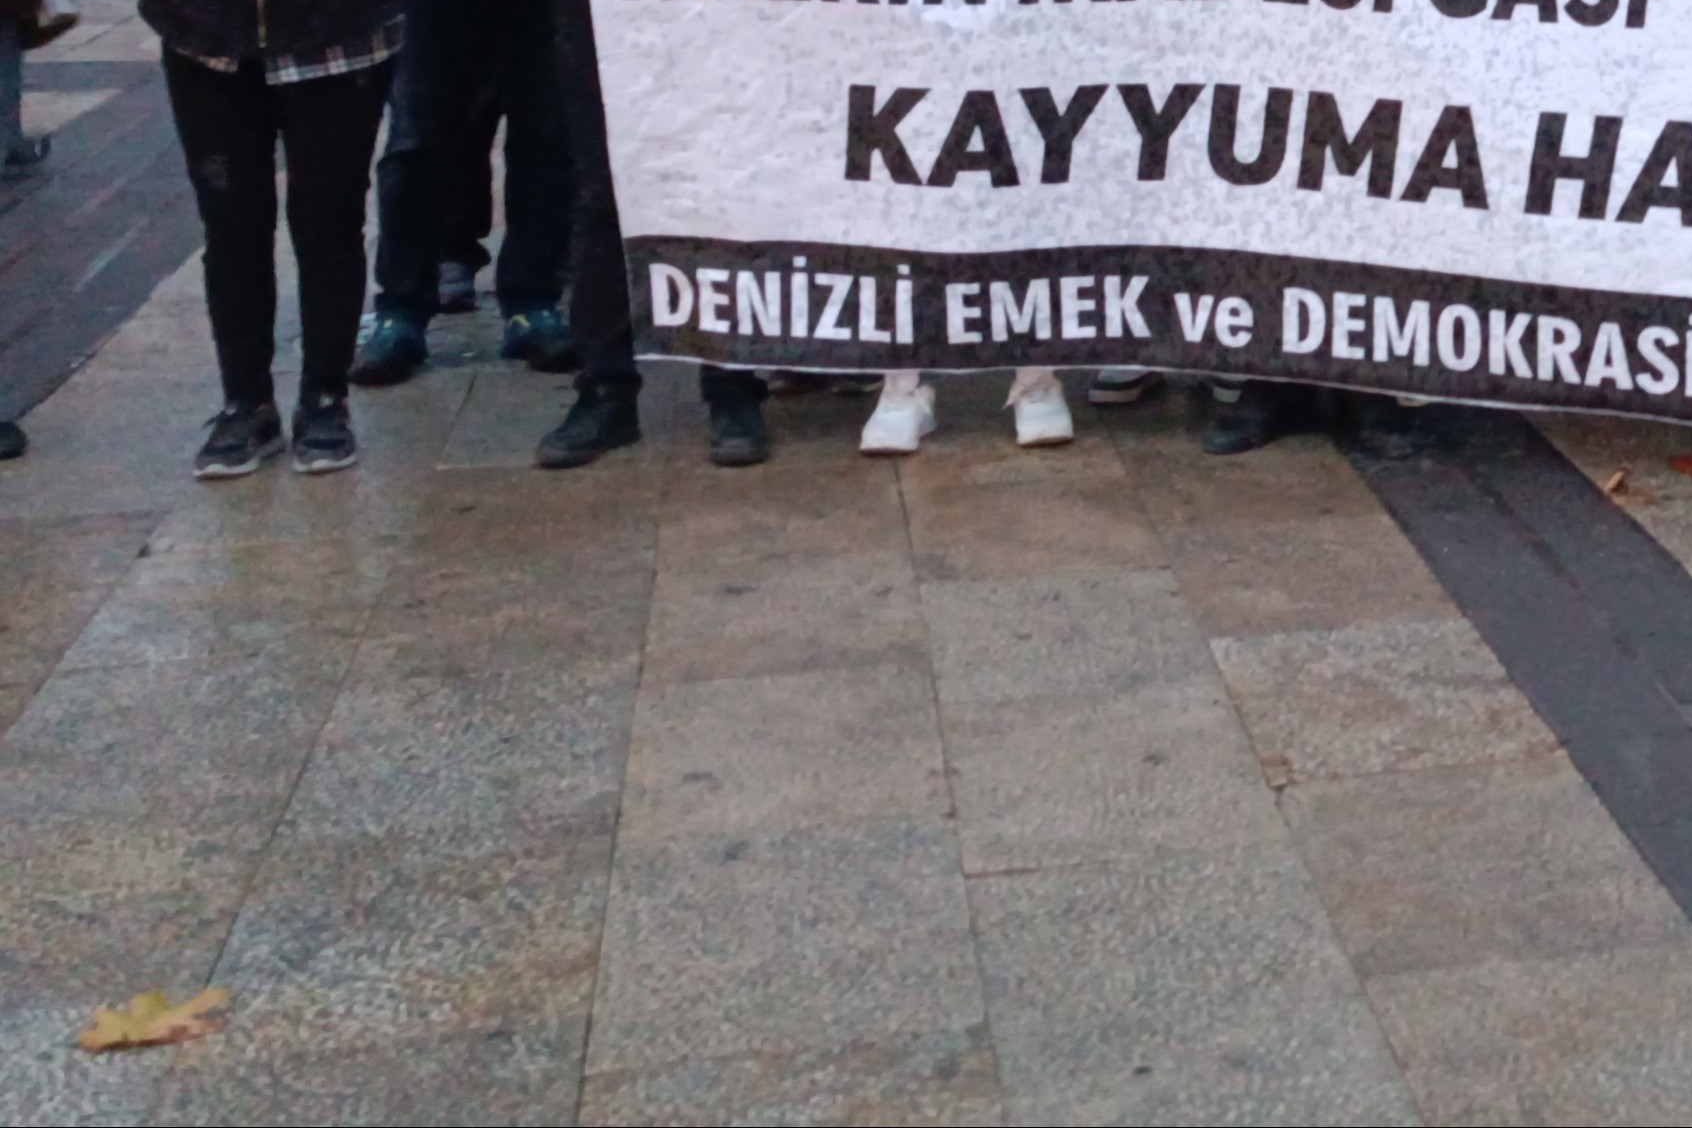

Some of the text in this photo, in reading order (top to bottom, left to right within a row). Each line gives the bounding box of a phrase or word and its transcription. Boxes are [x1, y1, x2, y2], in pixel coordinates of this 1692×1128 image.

[843, 82, 1490, 212] KAYYUMA
[649, 256, 914, 346] DENİZLİ
[945, 275, 1150, 346] EMEK
[1175, 293, 1255, 350] ve
